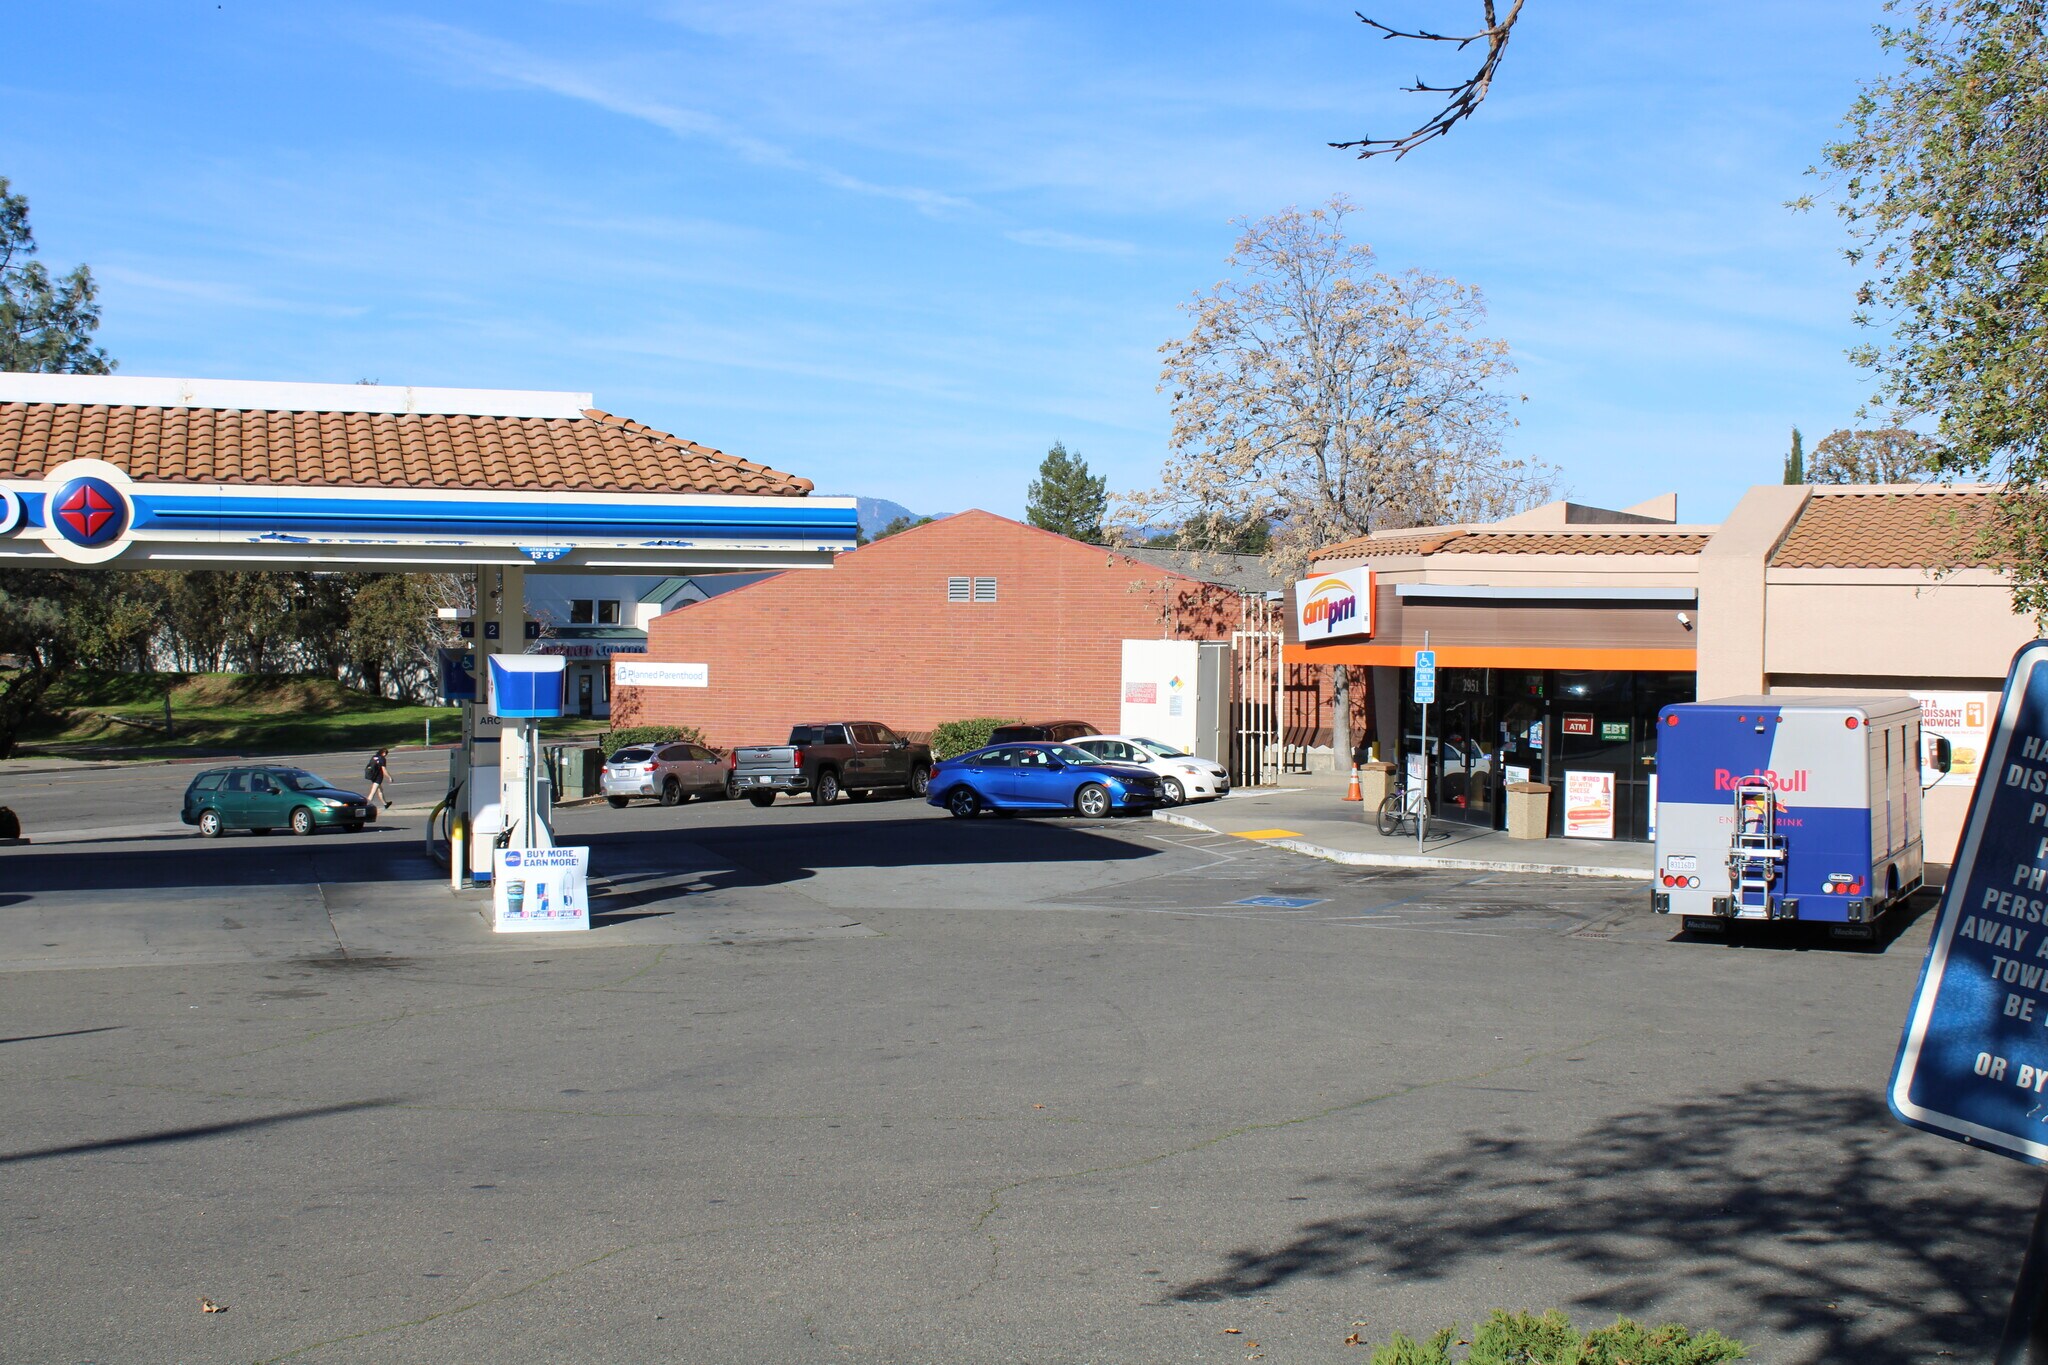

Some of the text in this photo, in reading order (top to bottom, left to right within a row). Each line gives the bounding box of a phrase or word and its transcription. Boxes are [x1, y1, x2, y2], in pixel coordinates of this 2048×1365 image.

[1303, 595, 1355, 633] ampm
[488, 625, 496, 635] 2
[628, 670, 703, 680] Planned Parenthood
[1463, 679, 1480, 692] 2951
[1931, 700, 1937, 708] A
[1569, 723, 1586, 731] ATM
[1602, 723, 1629, 734] EBT
[1715, 768, 1807, 792] Red Bull
[2006, 763, 2048, 795] DIS
[1776, 818, 1803, 826] RINK
[2013, 864, 2048, 893] PH
[1959, 914, 2029, 952] AWAY
[2003, 992, 2036, 1022] BE
[1973, 1051, 2048, 1093] OR BY
